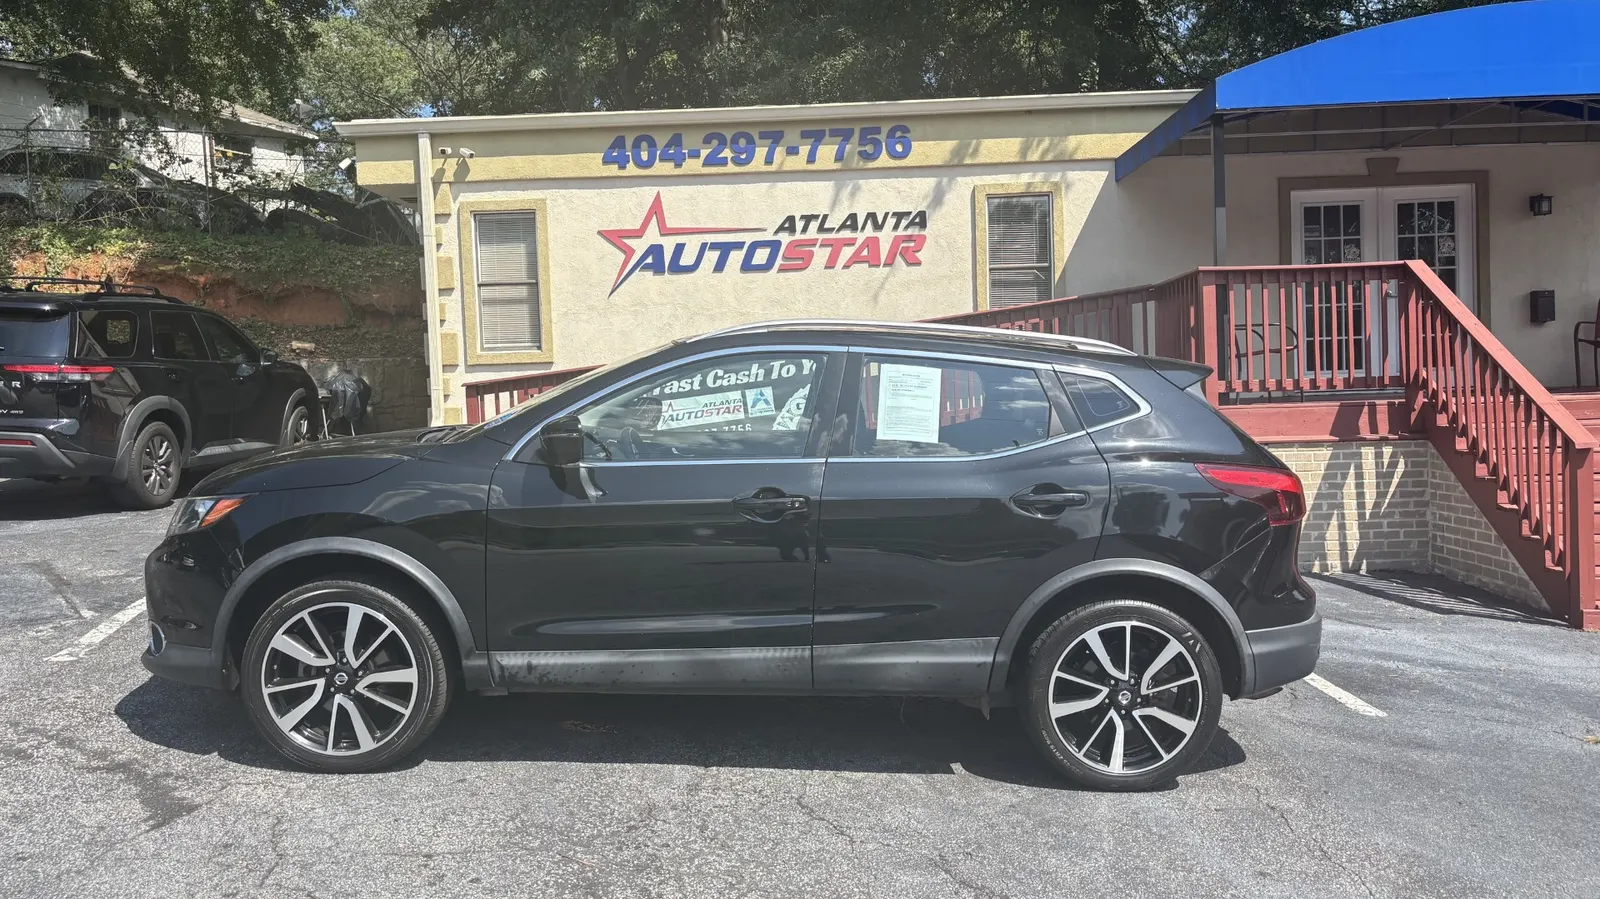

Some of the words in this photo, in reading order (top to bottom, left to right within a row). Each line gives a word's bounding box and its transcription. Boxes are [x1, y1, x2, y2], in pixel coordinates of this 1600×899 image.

[601, 124, 913, 170] 404-297-7756
[773, 210, 928, 236] ATLANTA
[622, 234, 928, 275] AUTOSTAR
[706, 363, 765, 388] Cash
[769, 360, 797, 380] To
[664, 404, 743, 424] AUTOSTAR
[701, 398, 743, 409] ATLANTA
